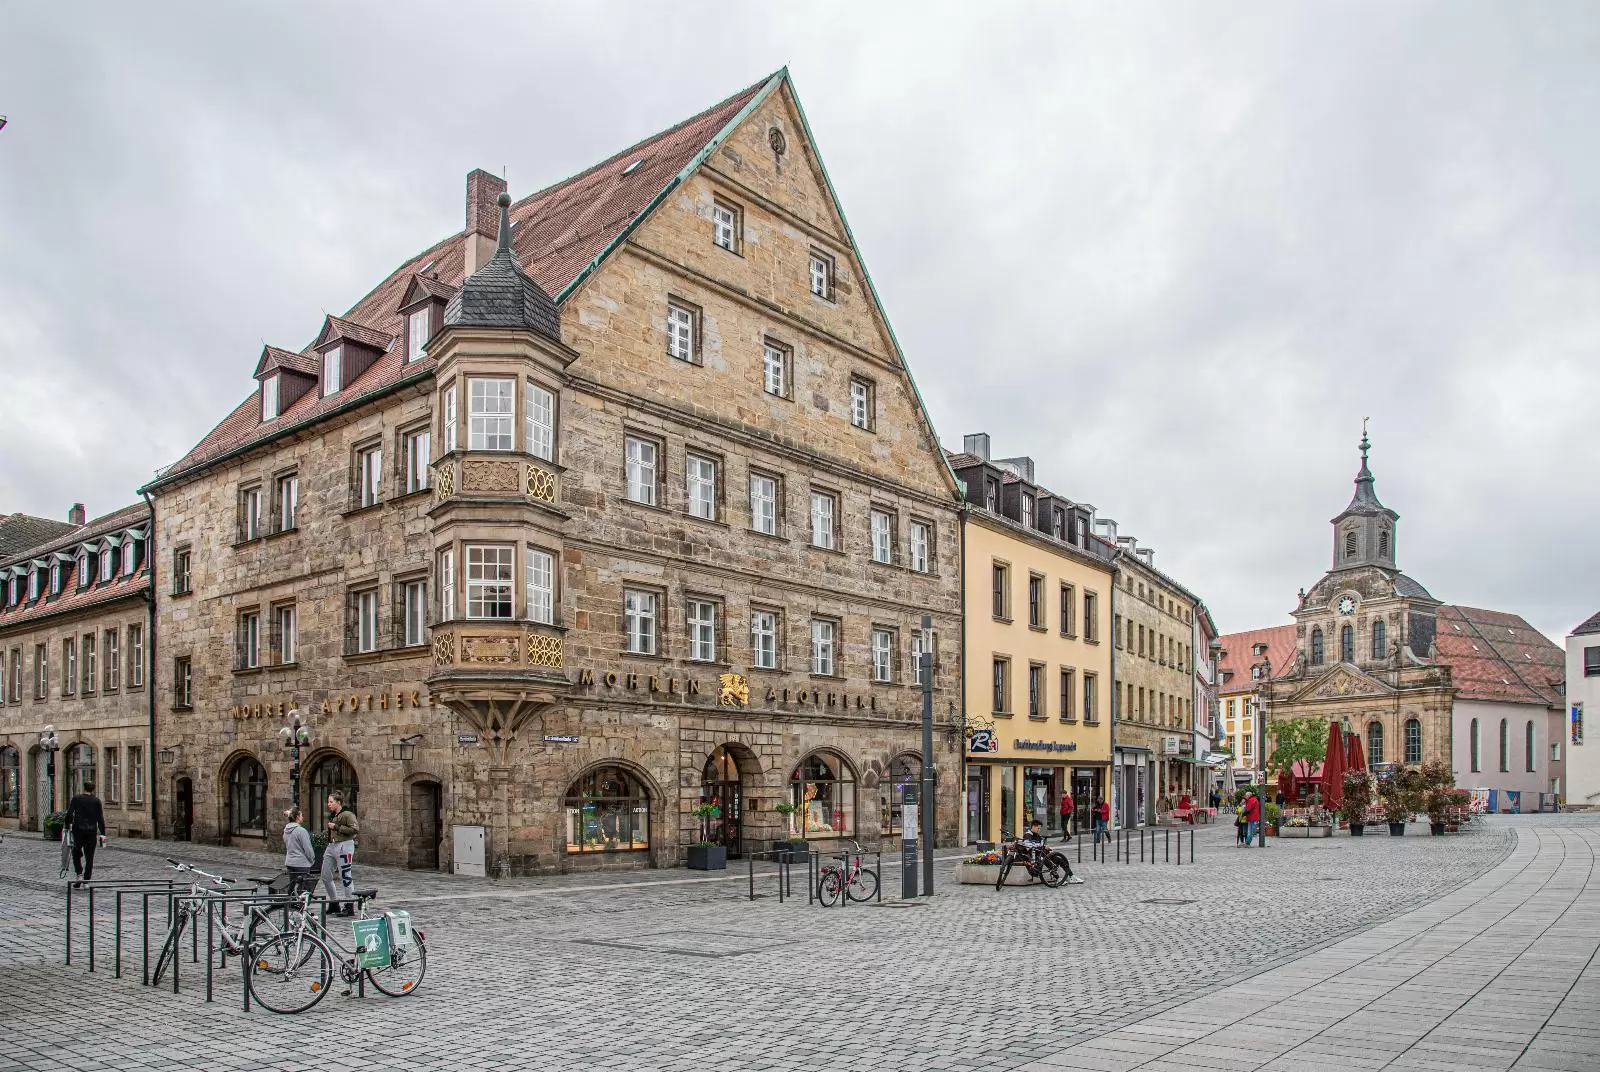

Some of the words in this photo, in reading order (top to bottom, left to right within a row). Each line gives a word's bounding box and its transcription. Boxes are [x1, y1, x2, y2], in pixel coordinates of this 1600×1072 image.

[232, 701, 298, 720] MOHREN
[321, 690, 436, 715] APOTHEKE
[580, 668, 700, 695] MOHREN
[766, 687, 876, 710] APOTHEKE
[339, 853, 352, 888] FILA
